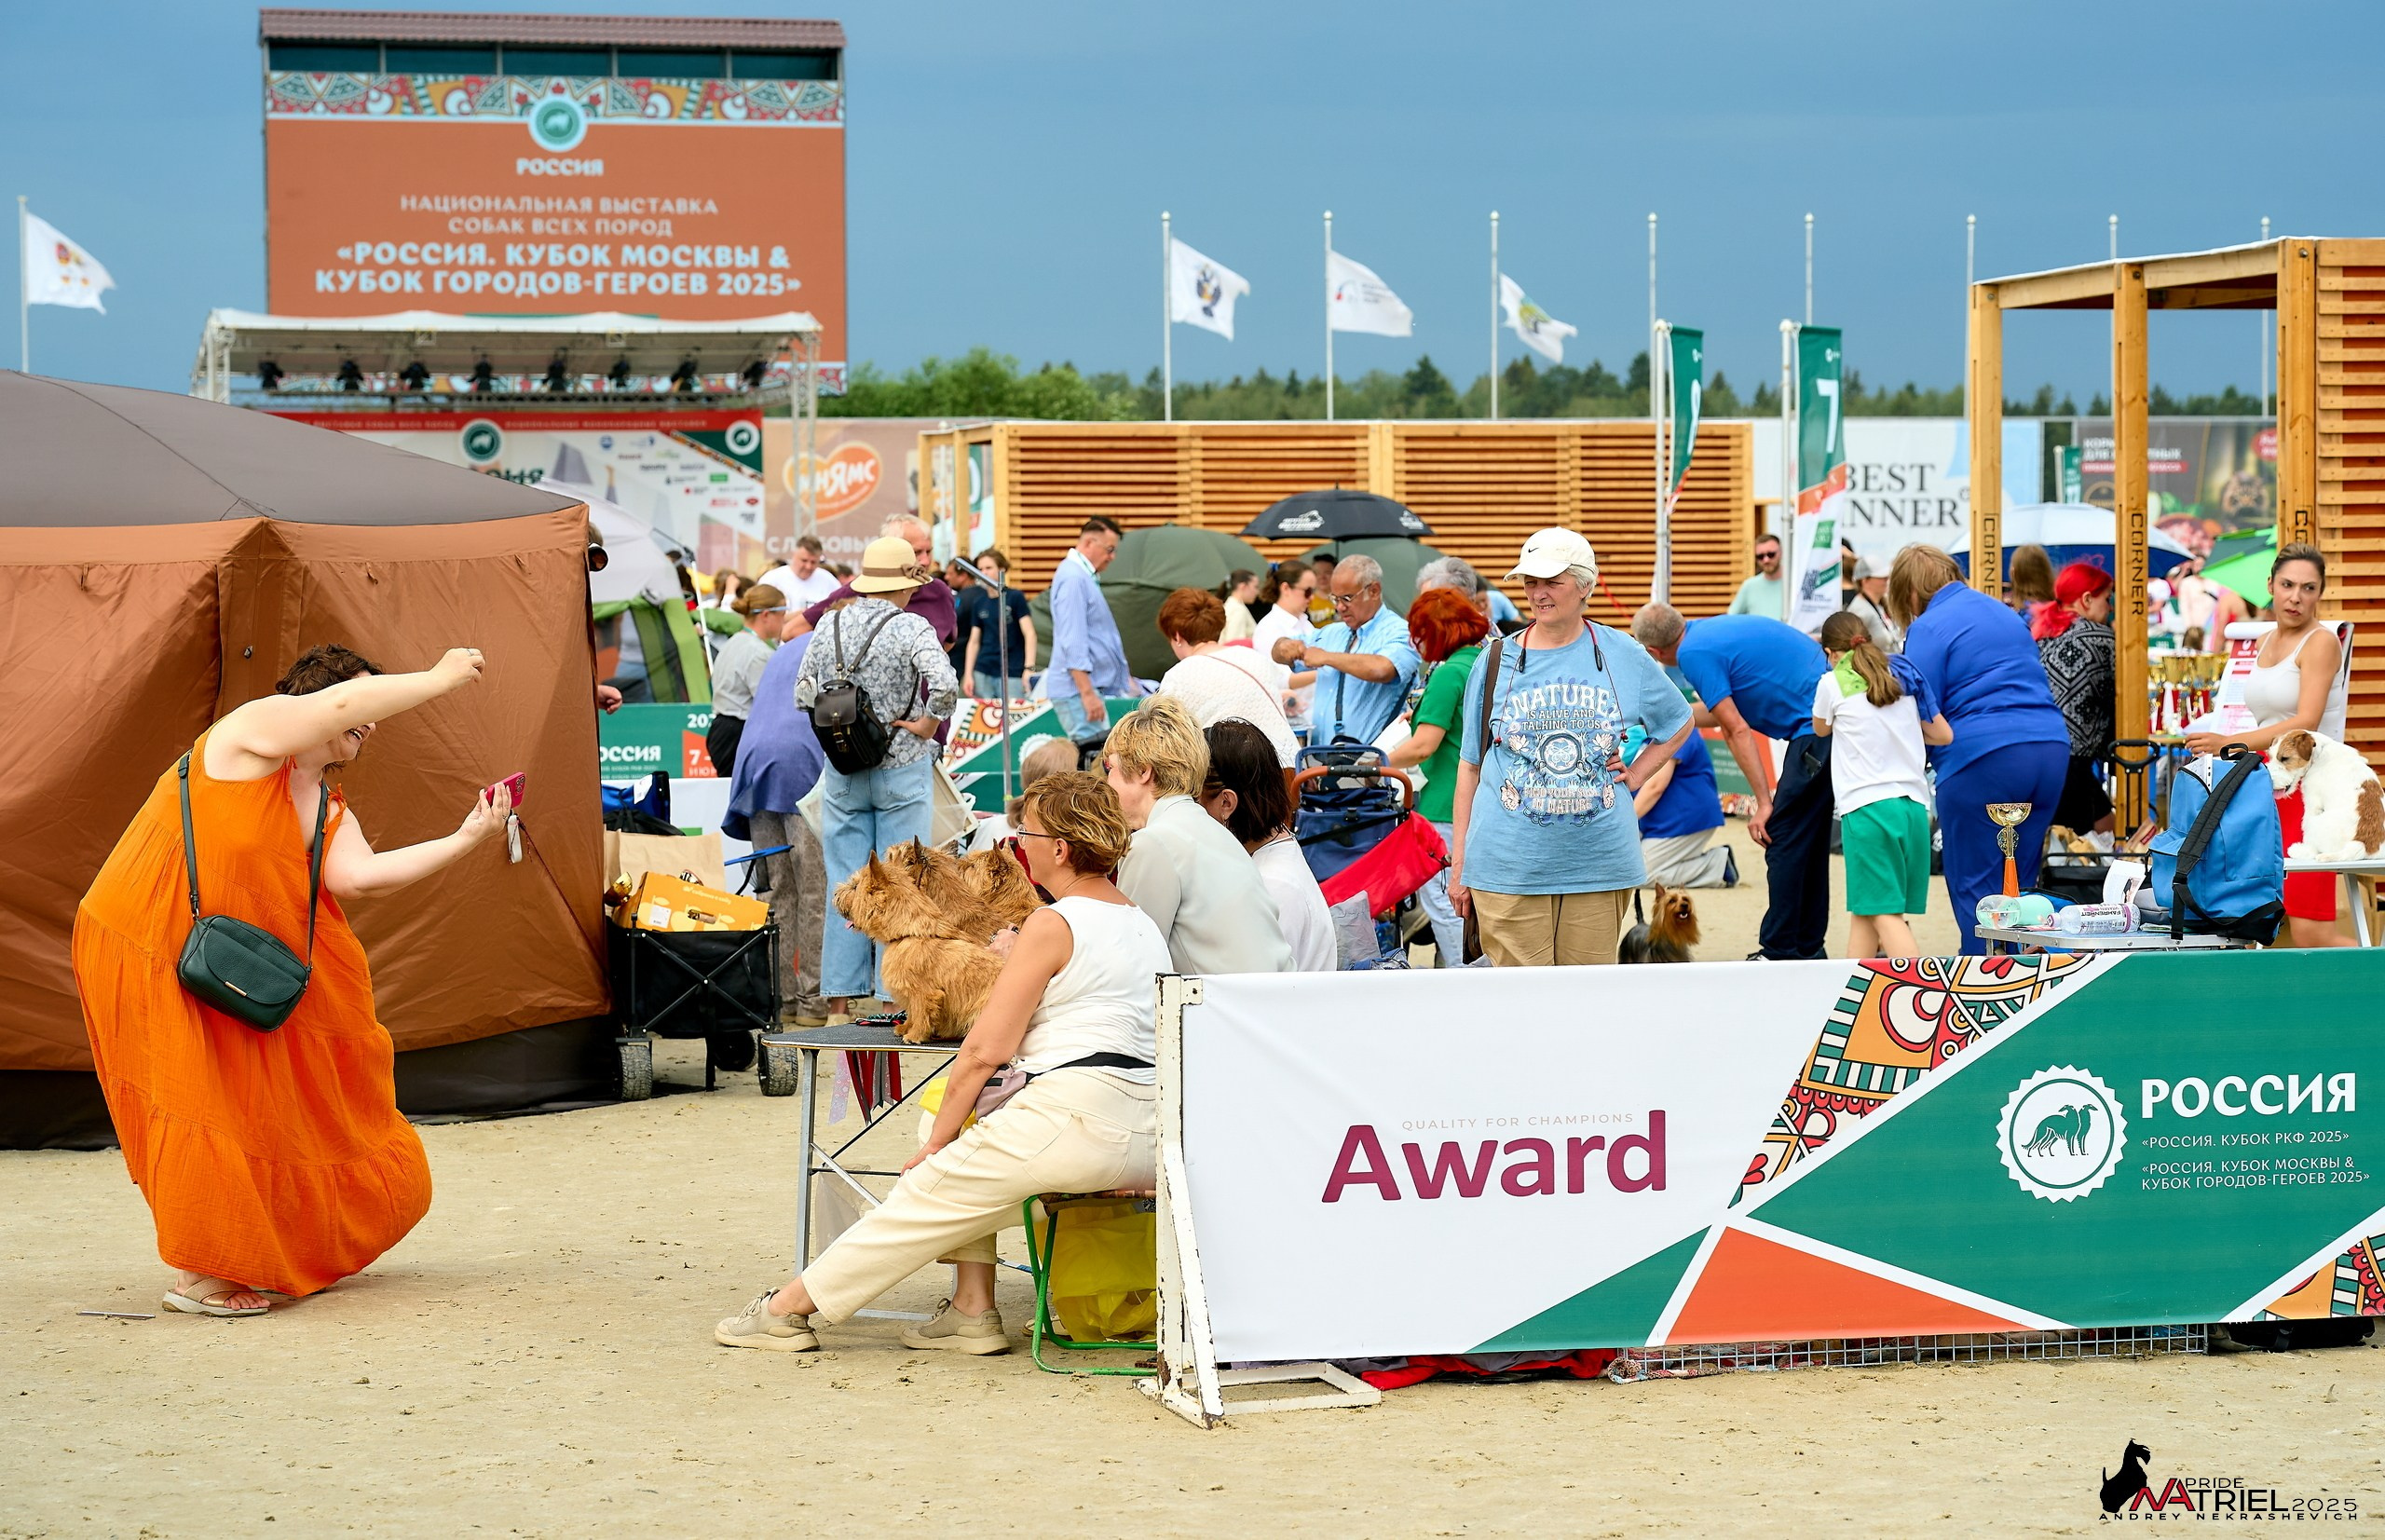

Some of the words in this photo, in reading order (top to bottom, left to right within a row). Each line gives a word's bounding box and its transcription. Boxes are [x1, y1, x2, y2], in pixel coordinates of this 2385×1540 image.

[515, 157, 605, 177] РОССИЯ
[400, 194, 593, 216] НАЦИОНАЛЬНАЯ
[599, 197, 718, 215] ВЫСТАВКА
[448, 217, 525, 235] СОБАК
[531, 217, 588, 236] ВСЕХ
[594, 218, 674, 238] ПОРОД
[336, 241, 497, 266] «РОССИЯ.
[505, 243, 612, 267] КУБОК
[621, 244, 760, 269] МОСКВЫ
[768, 246, 791, 269] &
[315, 269, 424, 293] КУБОК
[432, 271, 709, 299] ГОРОДОВ-ГЕРОЕВ
[716, 273, 802, 296] 2025»
[1817, 378, 1839, 454] 7
[1983, 518, 1996, 596] CORNE
[2132, 513, 2144, 616] CORNER
[1511, 683, 1611, 716] NATURE
[1521, 720, 1568, 730] TALKING
[1570, 719, 1585, 729] TO
[1587, 719, 1601, 729] US
[1526, 710, 1536, 720] IS
[1538, 709, 1570, 719] ALIVE
[1573, 708, 1595, 719] AND
[599, 745, 661, 762] ОССИЯ
[2141, 1072, 2356, 1119] РОССИЯ
[1401, 1118, 1478, 1131] QUALITY
[1485, 1116, 1520, 1127] FOR
[1527, 1112, 1634, 1126] CHAMPIONS
[2142, 1135, 2216, 1149] «РОССИЯ.
[2221, 1132, 2270, 1147] КУБОК
[2275, 1131, 2305, 1144] РКФ
[2309, 1130, 2350, 1143] 2025»
[1321, 1110, 1667, 1203] Award
[2142, 1161, 2216, 1175] «РОССИЯ.
[2221, 1158, 2270, 1172] КУБОК
[2274, 1156, 2340, 1170] МОСКВЫ
[2345, 1156, 2355, 1168] &
[2142, 1177, 2191, 1190] КУБОК
[2196, 1172, 2326, 1189] ГОРОДОВ-ГЕРОЕВ
[2330, 1170, 2371, 1183] 2025»
